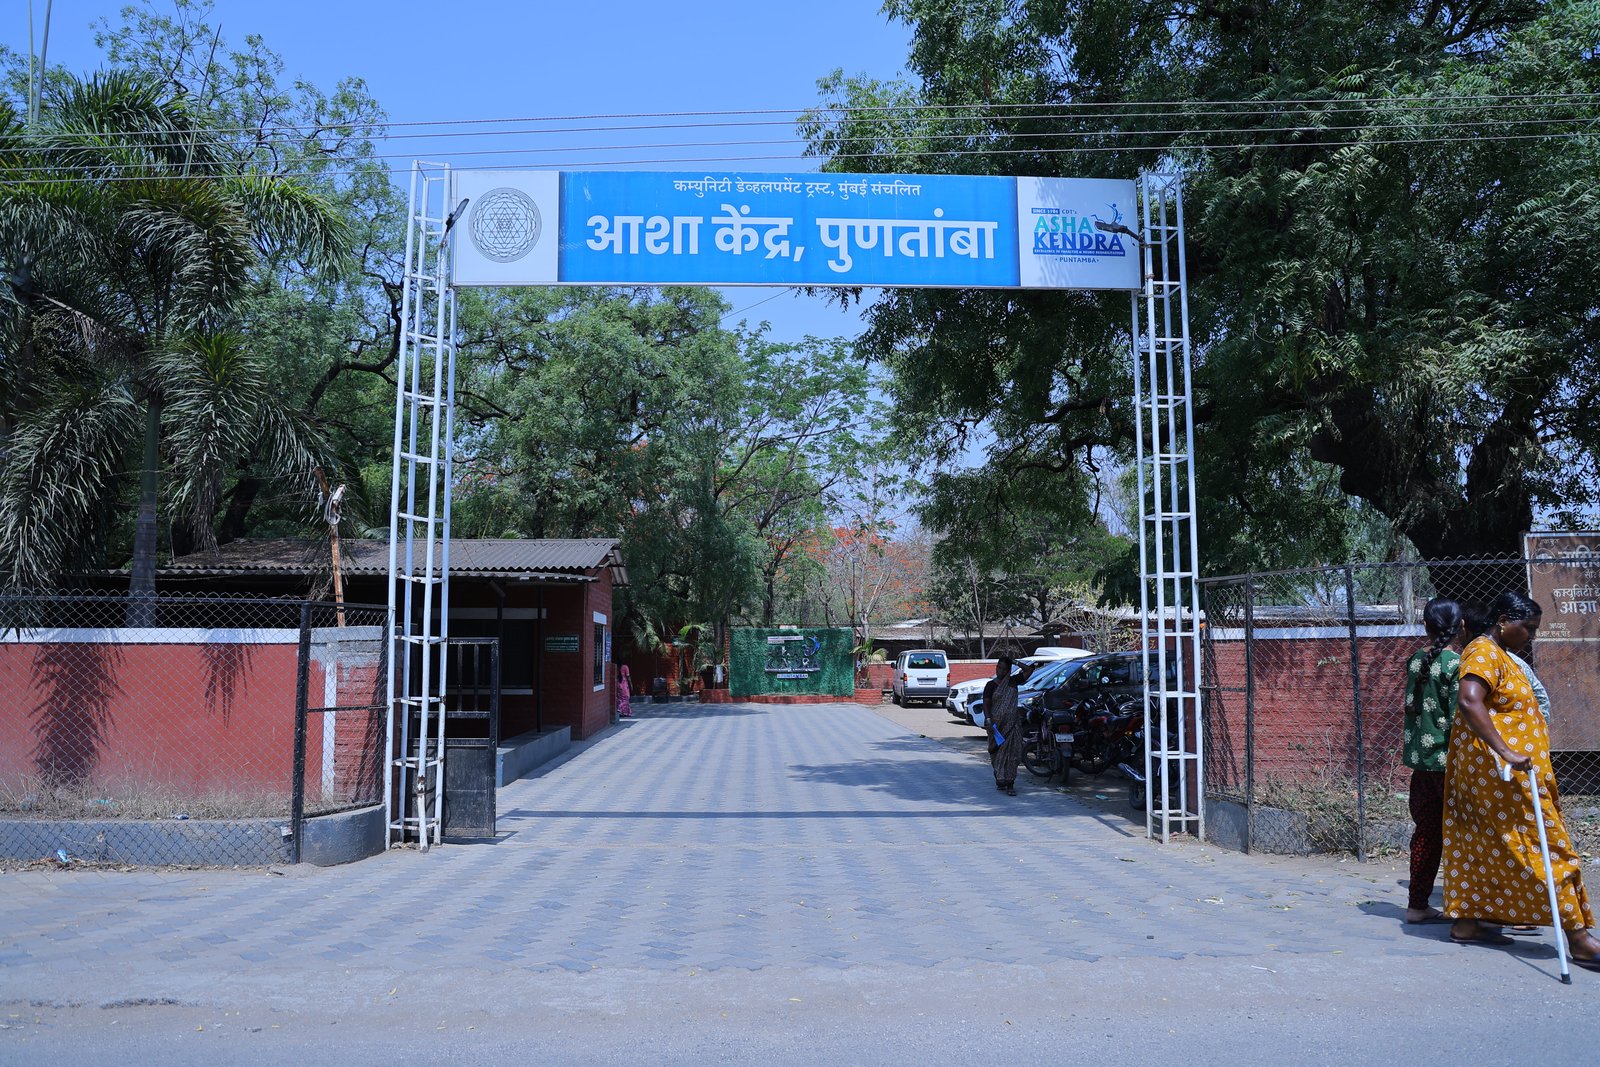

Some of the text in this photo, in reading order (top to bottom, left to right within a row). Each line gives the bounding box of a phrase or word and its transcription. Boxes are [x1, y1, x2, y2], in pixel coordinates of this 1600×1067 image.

[673, 176, 922, 200] कम्युनिटी डेव्हलपमेंट ट्रस्ट, मुंबई संचलित
[1034, 216, 1093, 233] ASHA
[586, 203, 998, 274] आशा केंद्र, पुणतांबा
[1034, 232, 1124, 250] KENDRA
[1559, 600, 1597, 614] आशा
